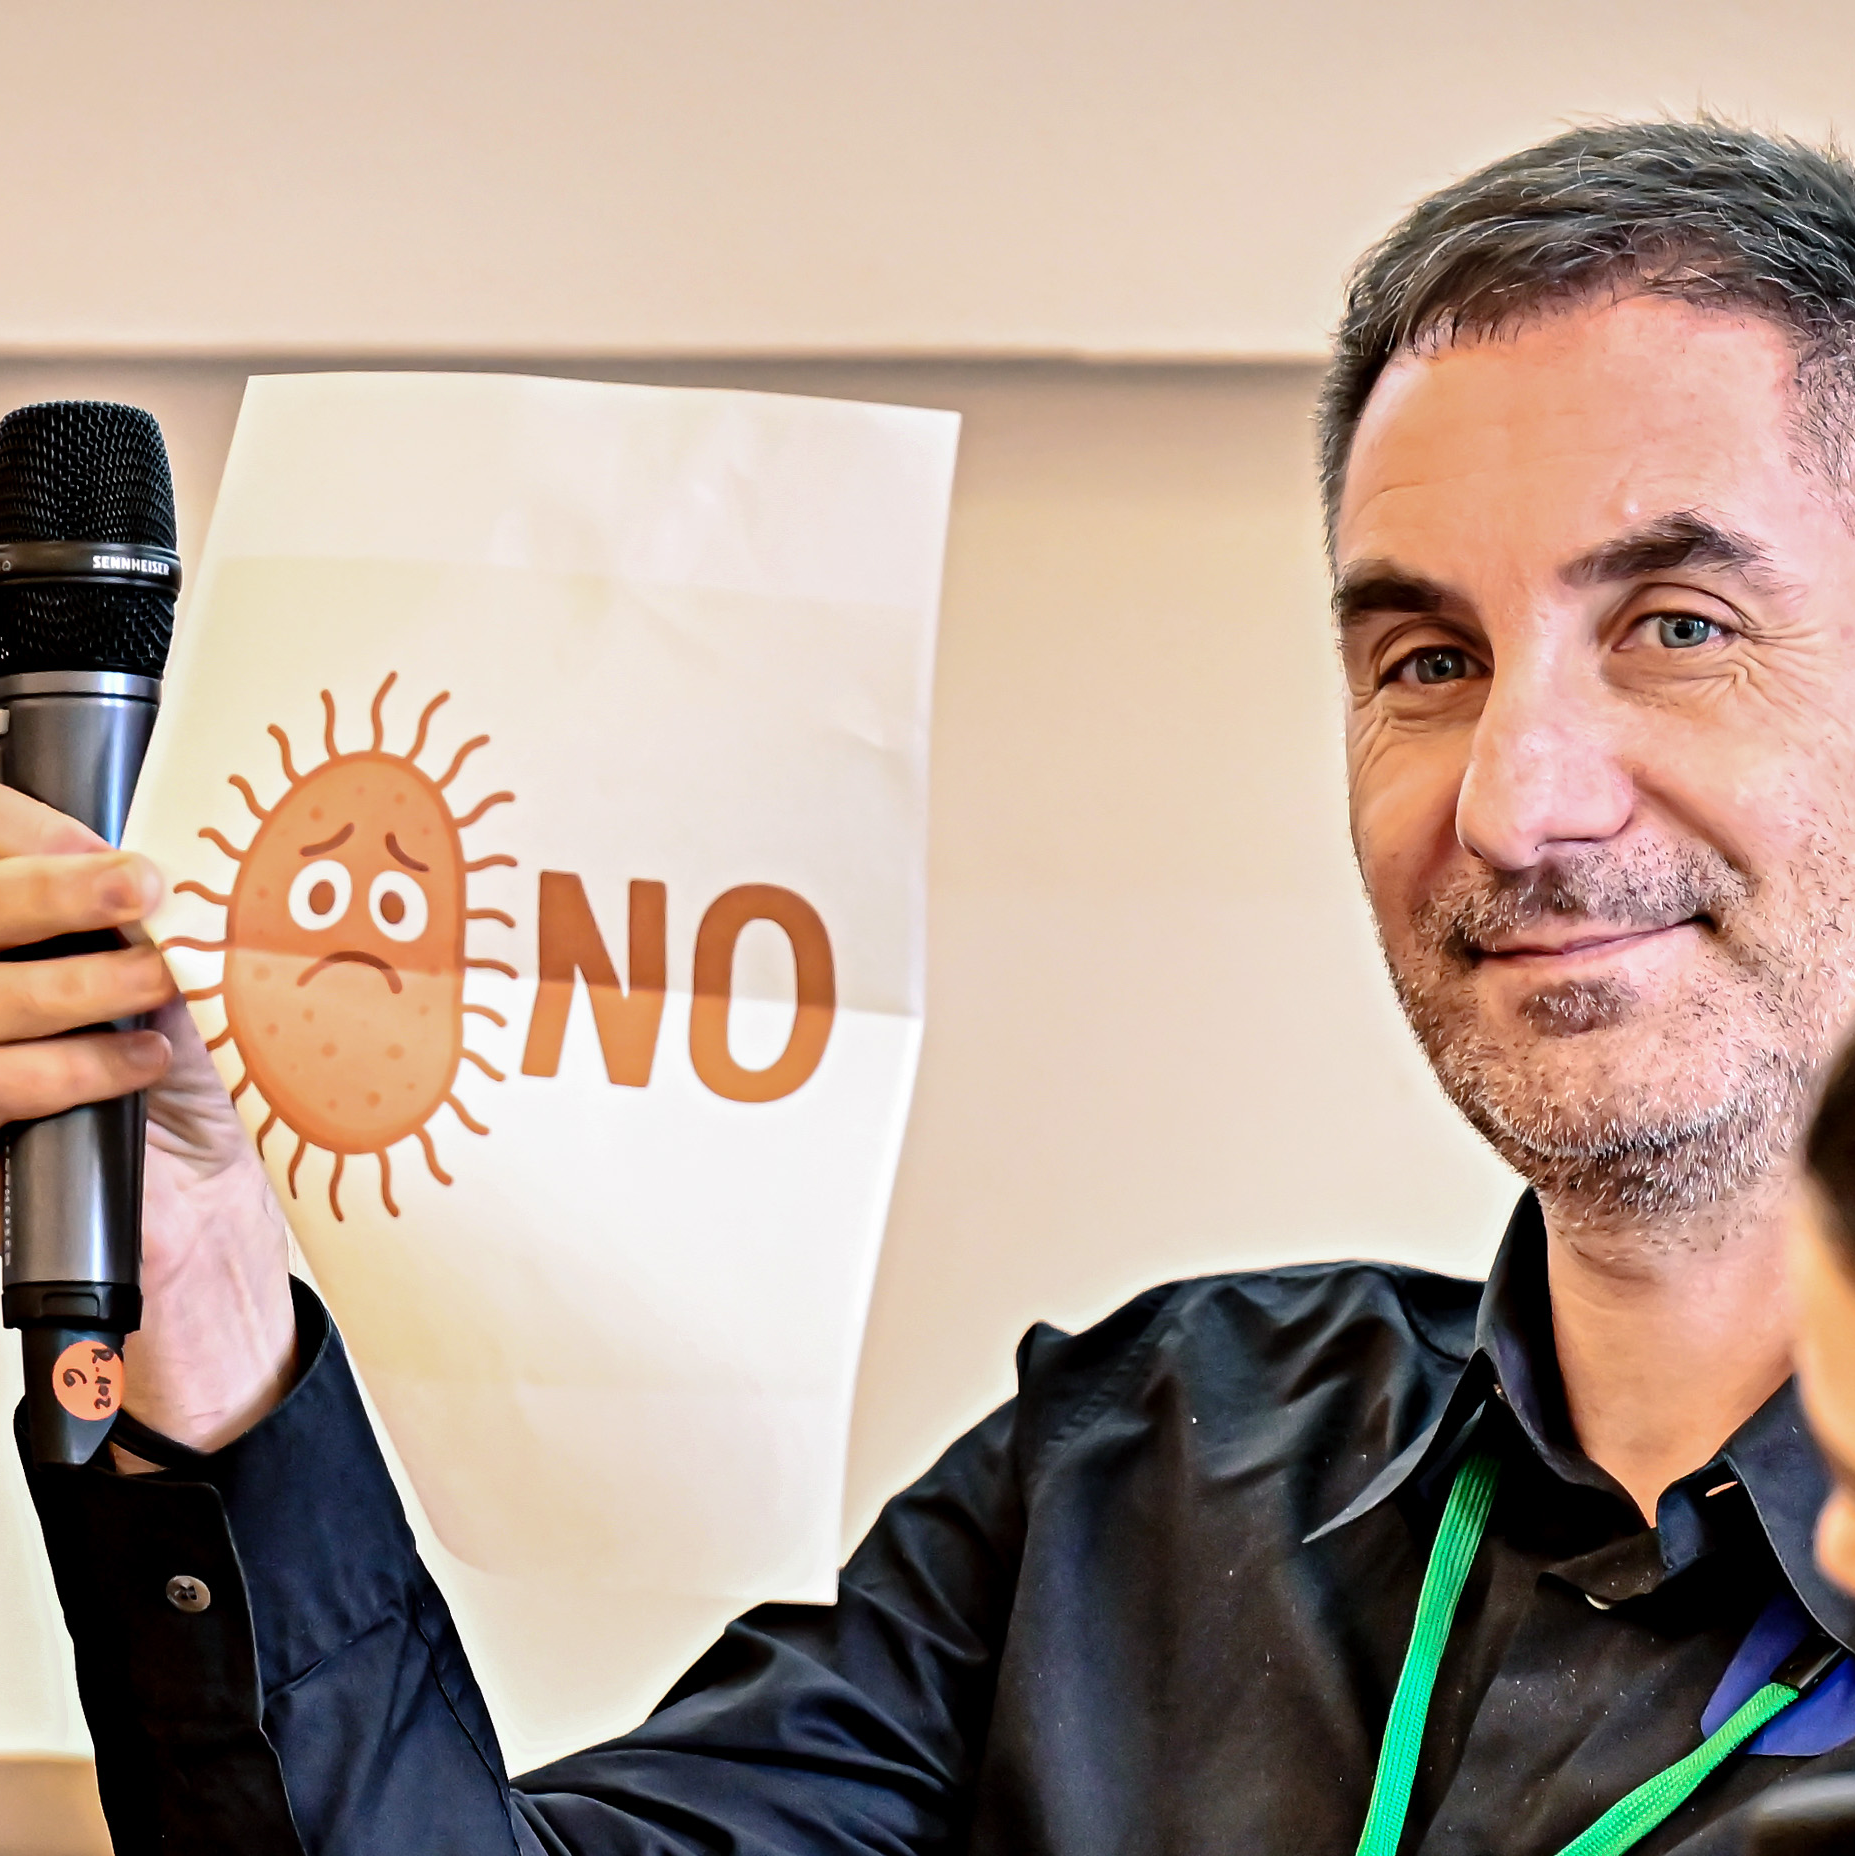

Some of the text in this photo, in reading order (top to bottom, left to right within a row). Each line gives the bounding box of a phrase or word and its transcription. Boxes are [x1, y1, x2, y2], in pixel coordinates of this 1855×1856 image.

[92, 555, 170, 576] SENNHEISER
[521, 871, 836, 1102] NO
[62, 1368, 88, 1388] 6
